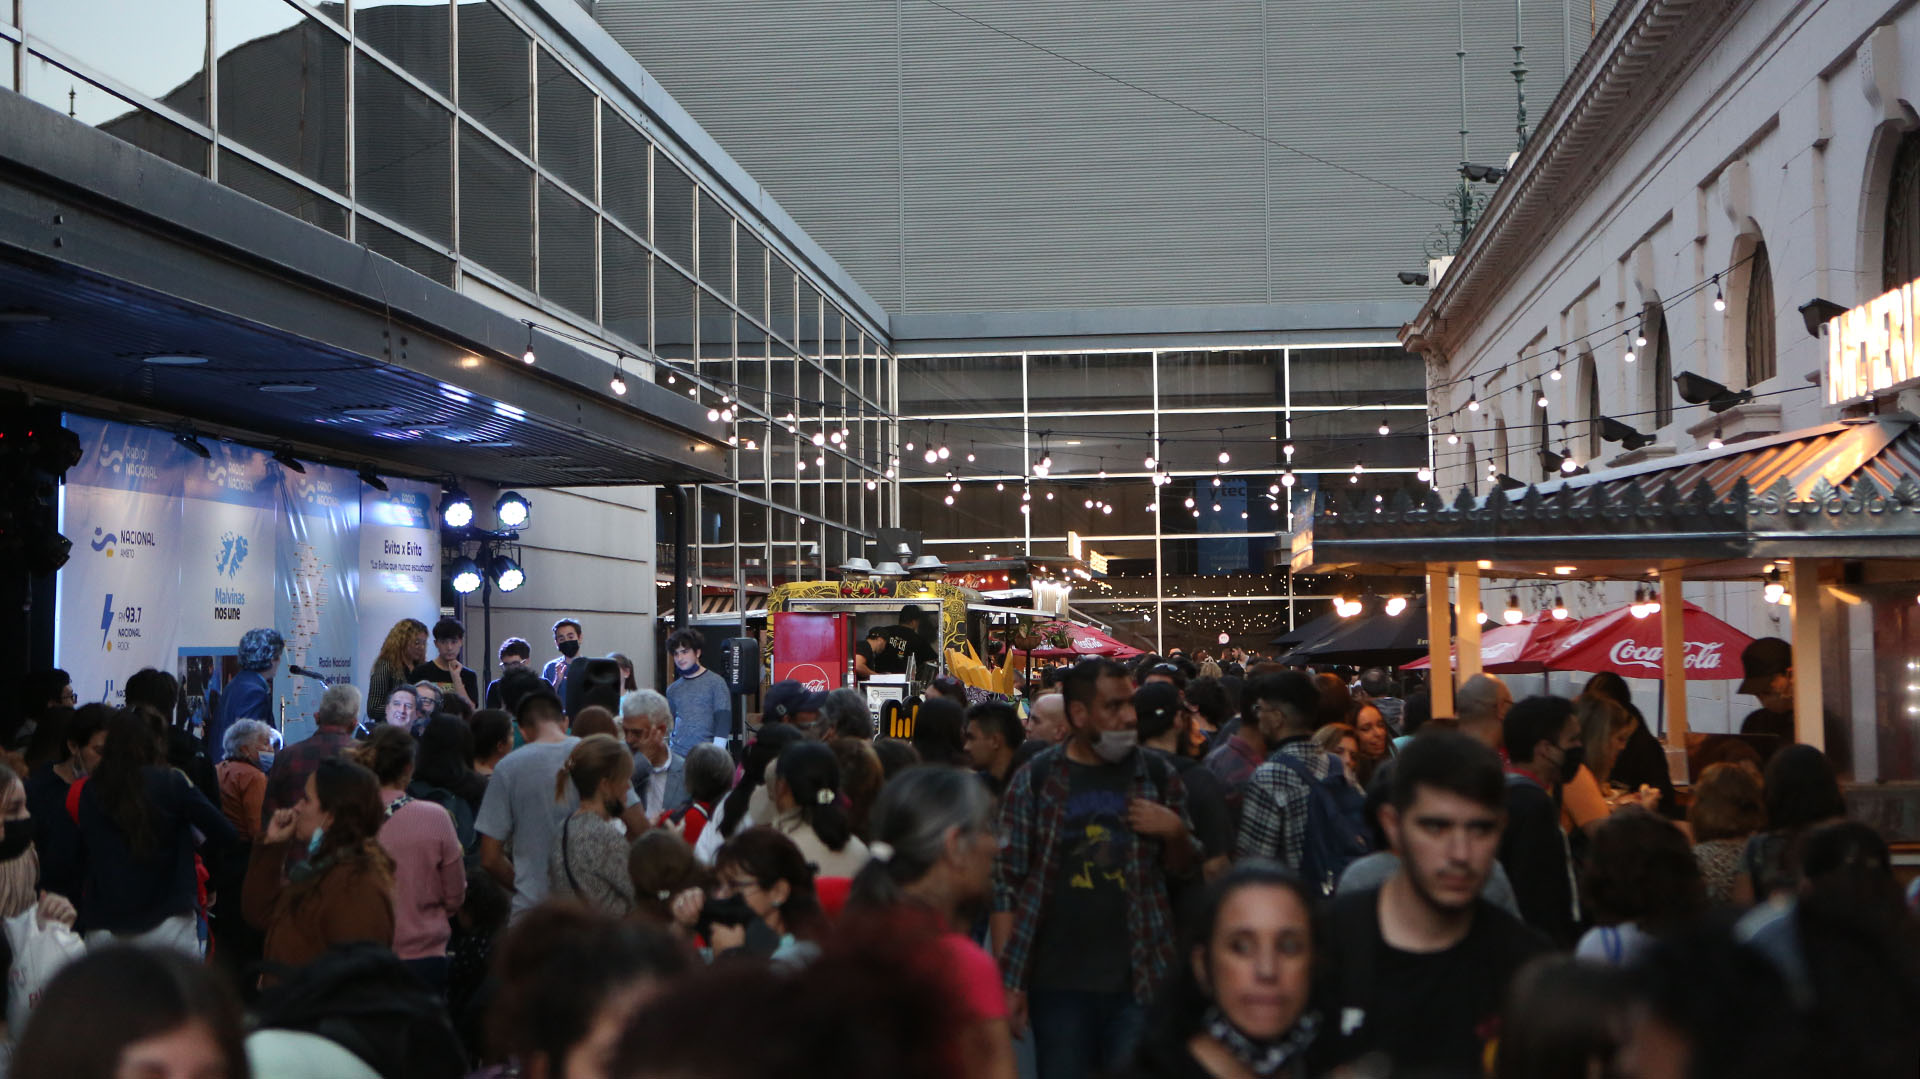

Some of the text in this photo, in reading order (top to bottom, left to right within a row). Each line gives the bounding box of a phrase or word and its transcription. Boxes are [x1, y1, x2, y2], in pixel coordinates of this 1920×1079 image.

[126, 447, 146, 460] RADIO
[126, 463, 158, 479] NACIONAL
[228, 462, 245, 476] RADIO
[228, 477, 254, 493] NACIONAL
[402, 494, 416, 504] RADIO
[121, 530, 156, 546] NACIONAL
[384, 540, 401, 555] Evita
[407, 541, 422, 556] Evita
[215, 587, 245, 606] Malvinas
[214, 607, 241, 620] nos une
[118, 628, 141, 638] NACIONAL
